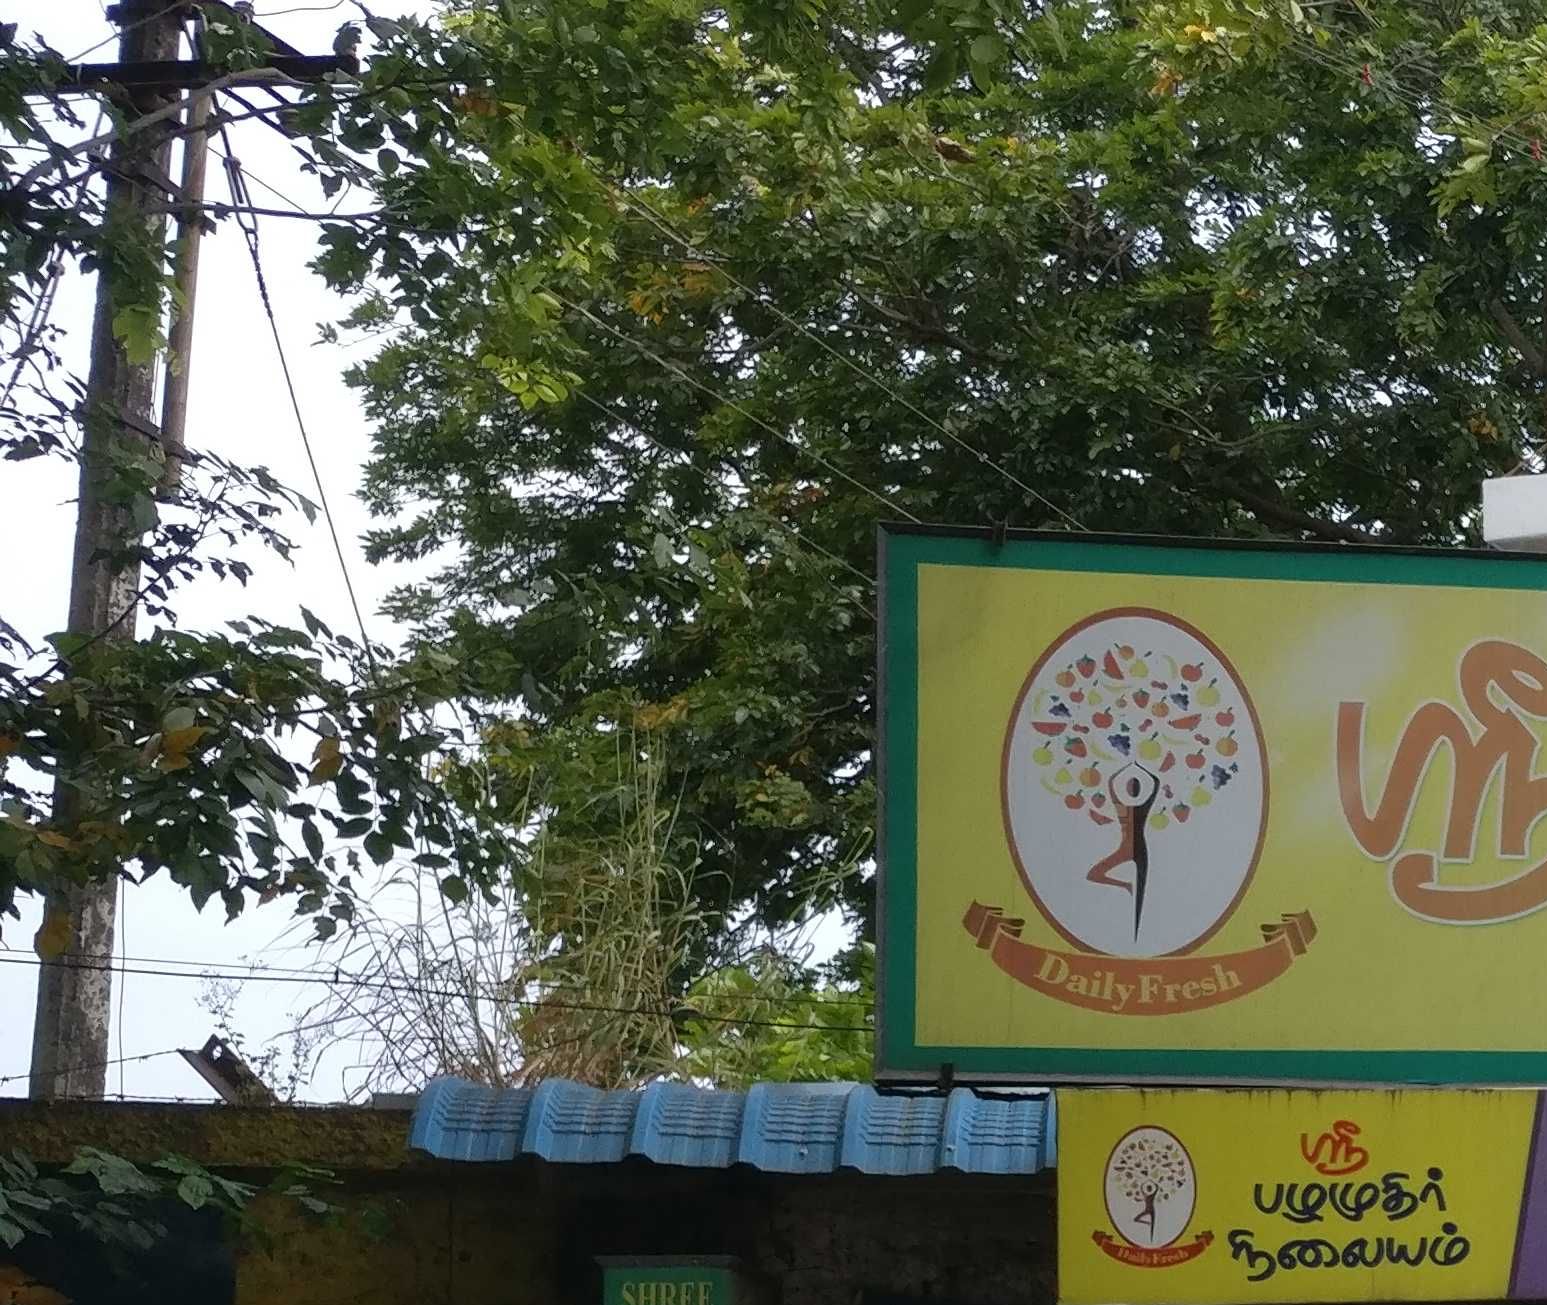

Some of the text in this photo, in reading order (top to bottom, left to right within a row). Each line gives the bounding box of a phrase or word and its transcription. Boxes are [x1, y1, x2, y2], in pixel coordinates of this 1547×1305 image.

[1034, 953, 1243, 1010] Daily Fresh
[1253, 1167, 1447, 1221] பழமுதிர்
[1230, 1222, 1470, 1281] நிலையம்
